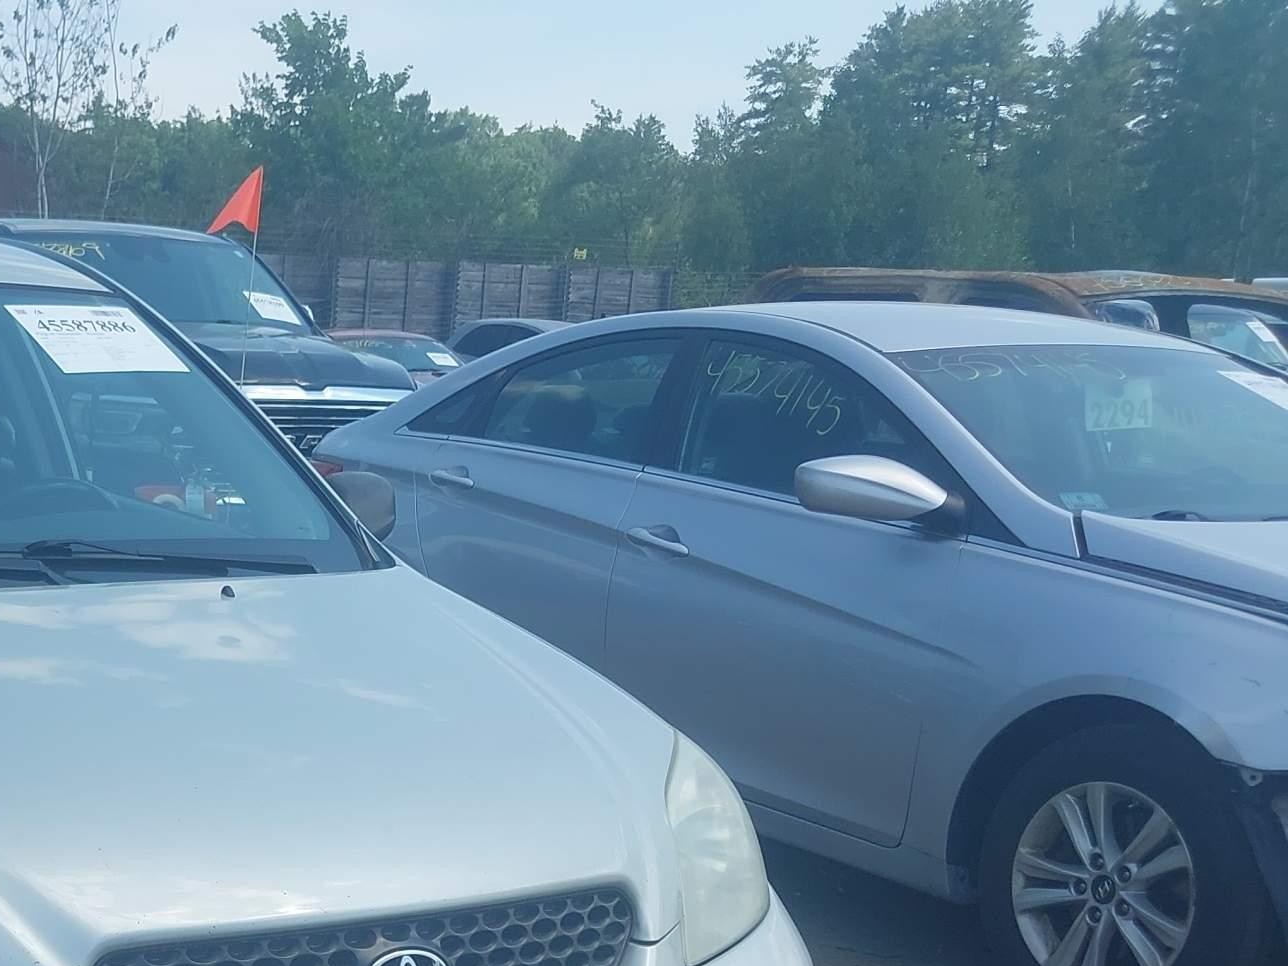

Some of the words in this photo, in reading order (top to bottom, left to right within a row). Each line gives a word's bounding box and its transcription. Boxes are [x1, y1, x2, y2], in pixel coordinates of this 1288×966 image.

[37, 319, 137, 333] 45587886
[707, 350, 847, 436] 45574145
[1089, 396, 1150, 428] 2294
